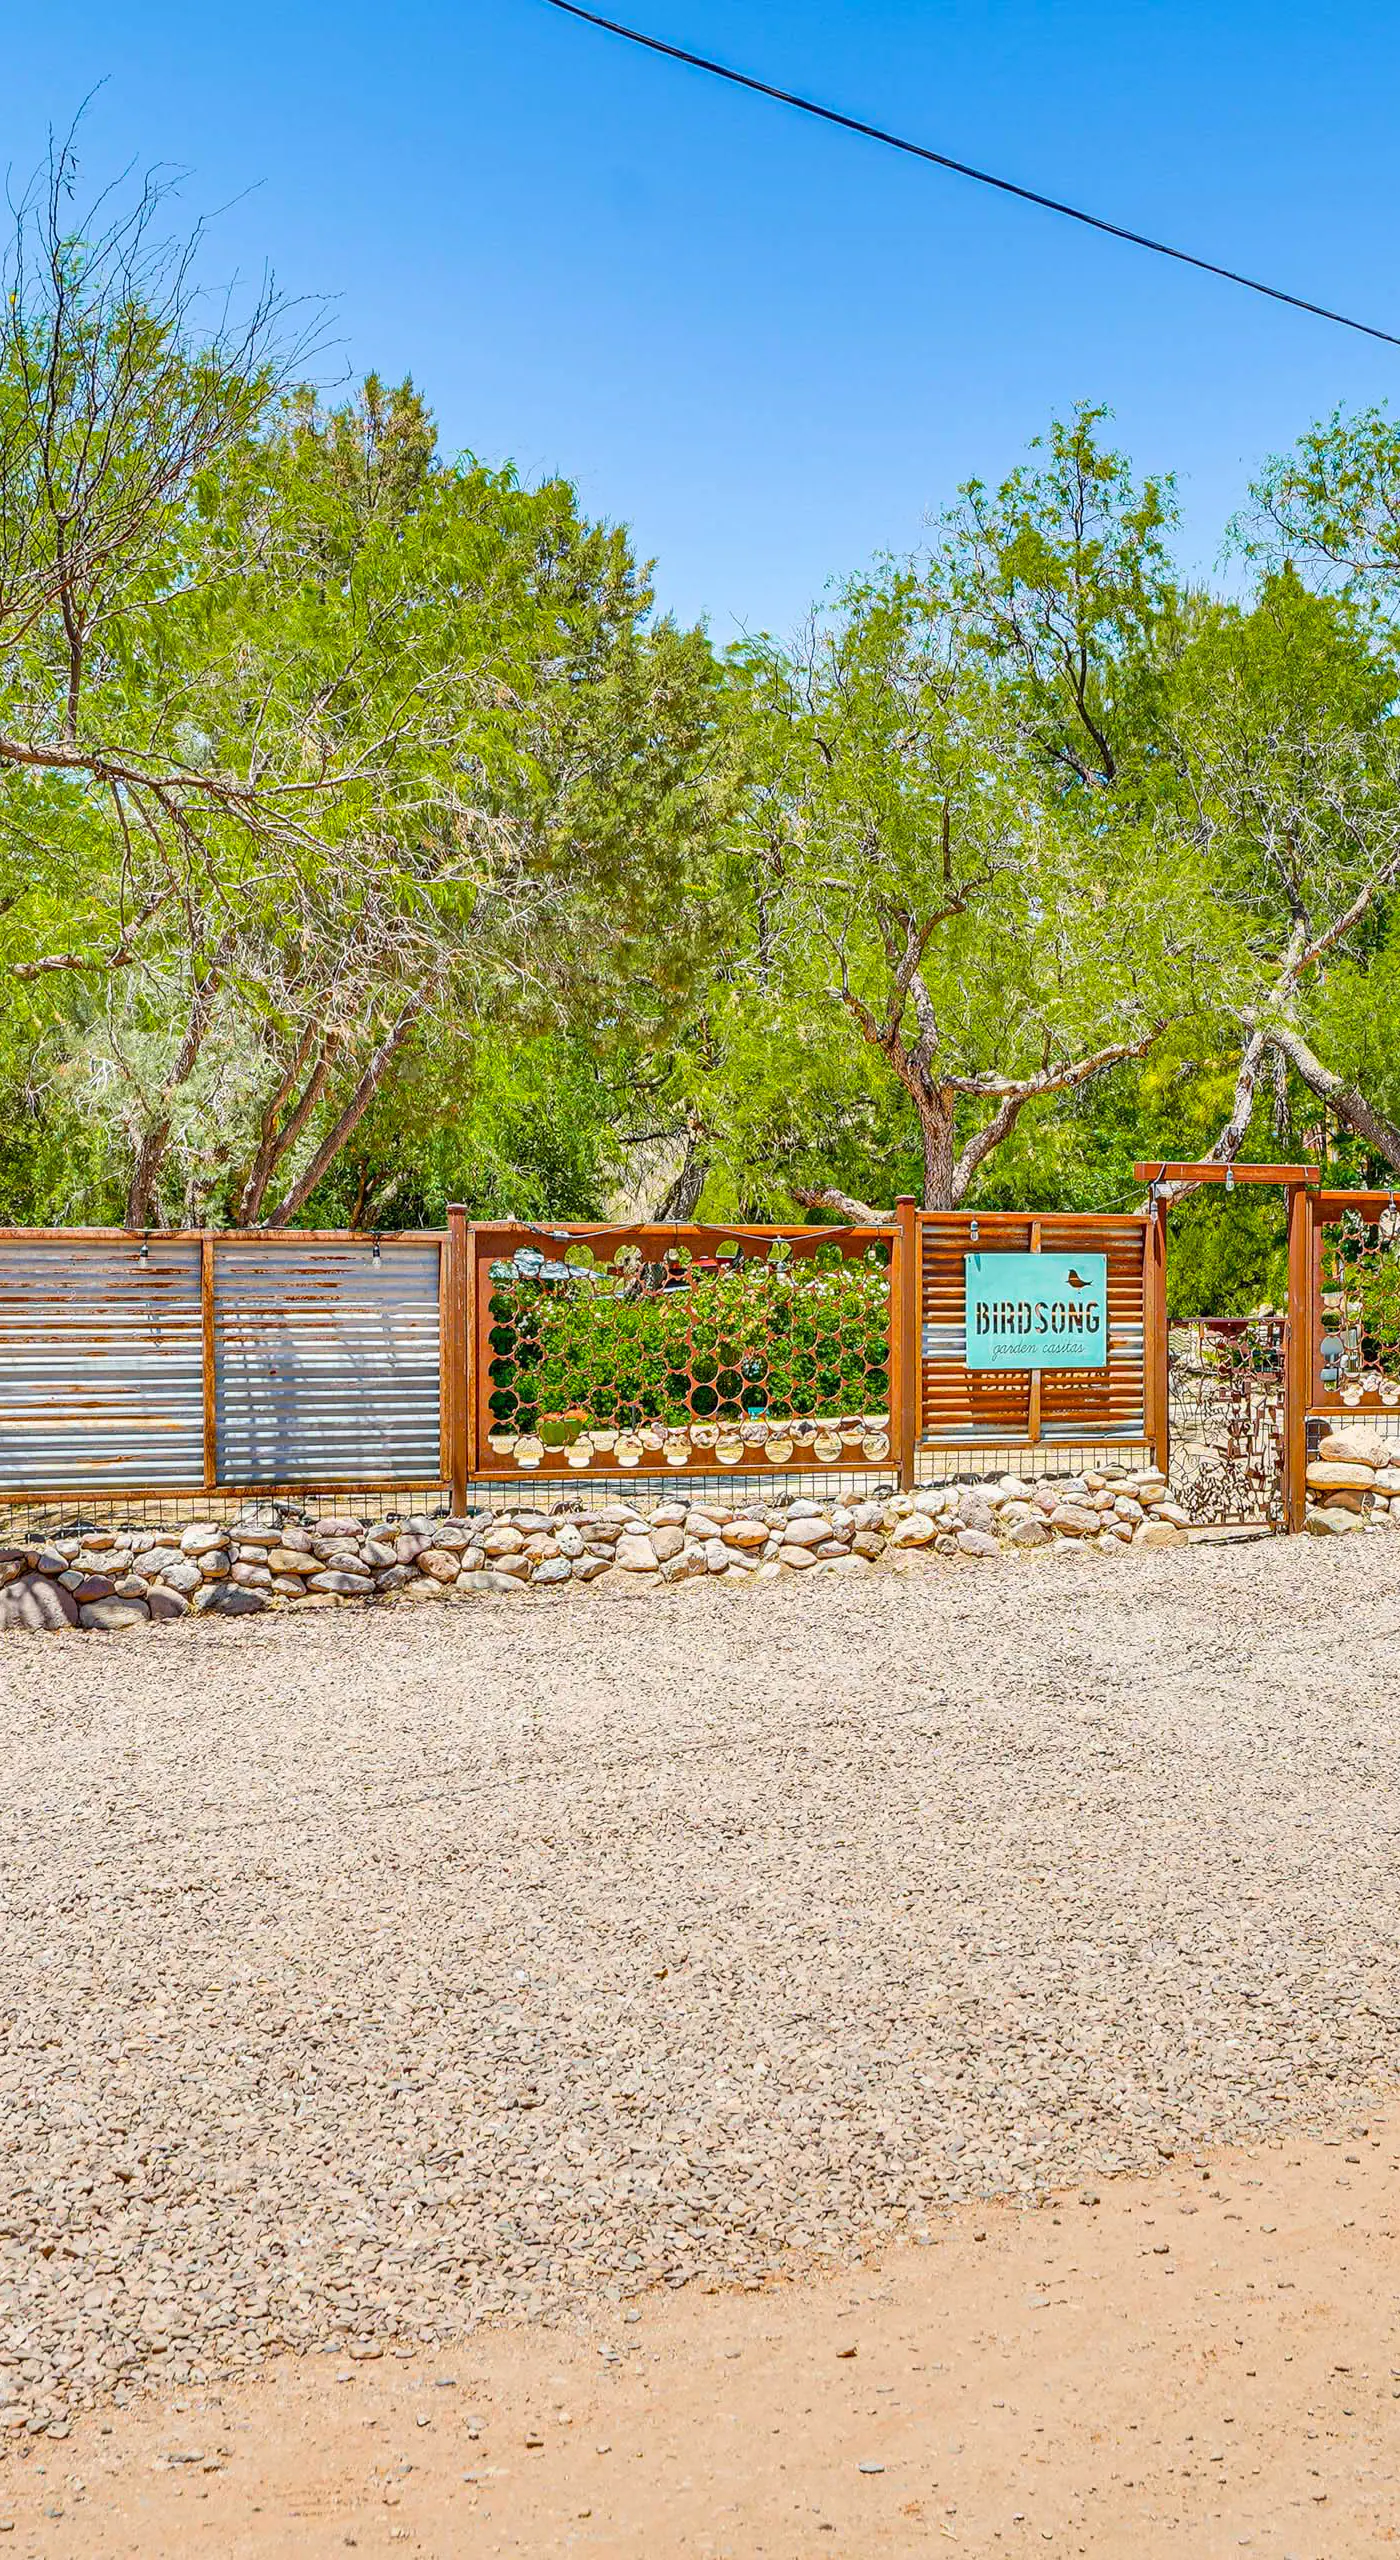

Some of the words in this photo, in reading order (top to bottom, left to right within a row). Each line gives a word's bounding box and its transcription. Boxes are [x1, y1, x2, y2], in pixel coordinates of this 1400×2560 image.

[976, 1301, 1100, 1335] BIRDSONG
[992, 1340, 1037, 1361] garden
[1042, 1341, 1085, 1354] casitas
